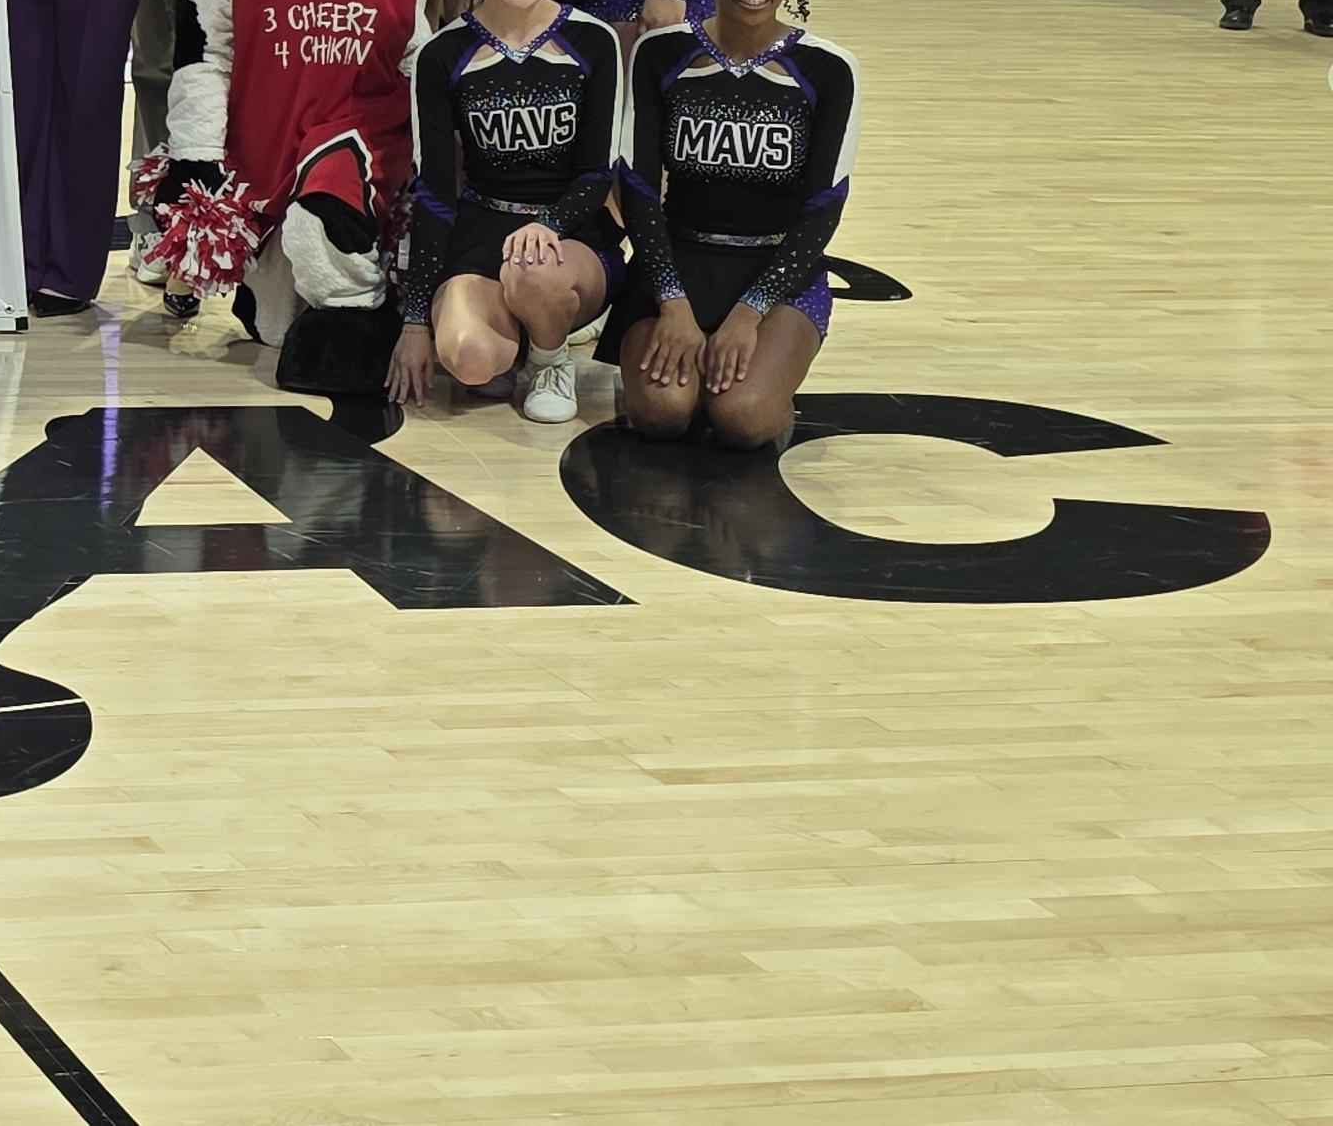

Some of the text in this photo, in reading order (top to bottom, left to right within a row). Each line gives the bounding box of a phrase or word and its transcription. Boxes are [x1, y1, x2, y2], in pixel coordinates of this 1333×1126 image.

[263, 0, 379, 34] 3 CHEERZ
[273, 36, 374, 70] 4 CHIKIN
[467, 101, 578, 154] MAVS
[674, 116, 794, 170] MAVS
